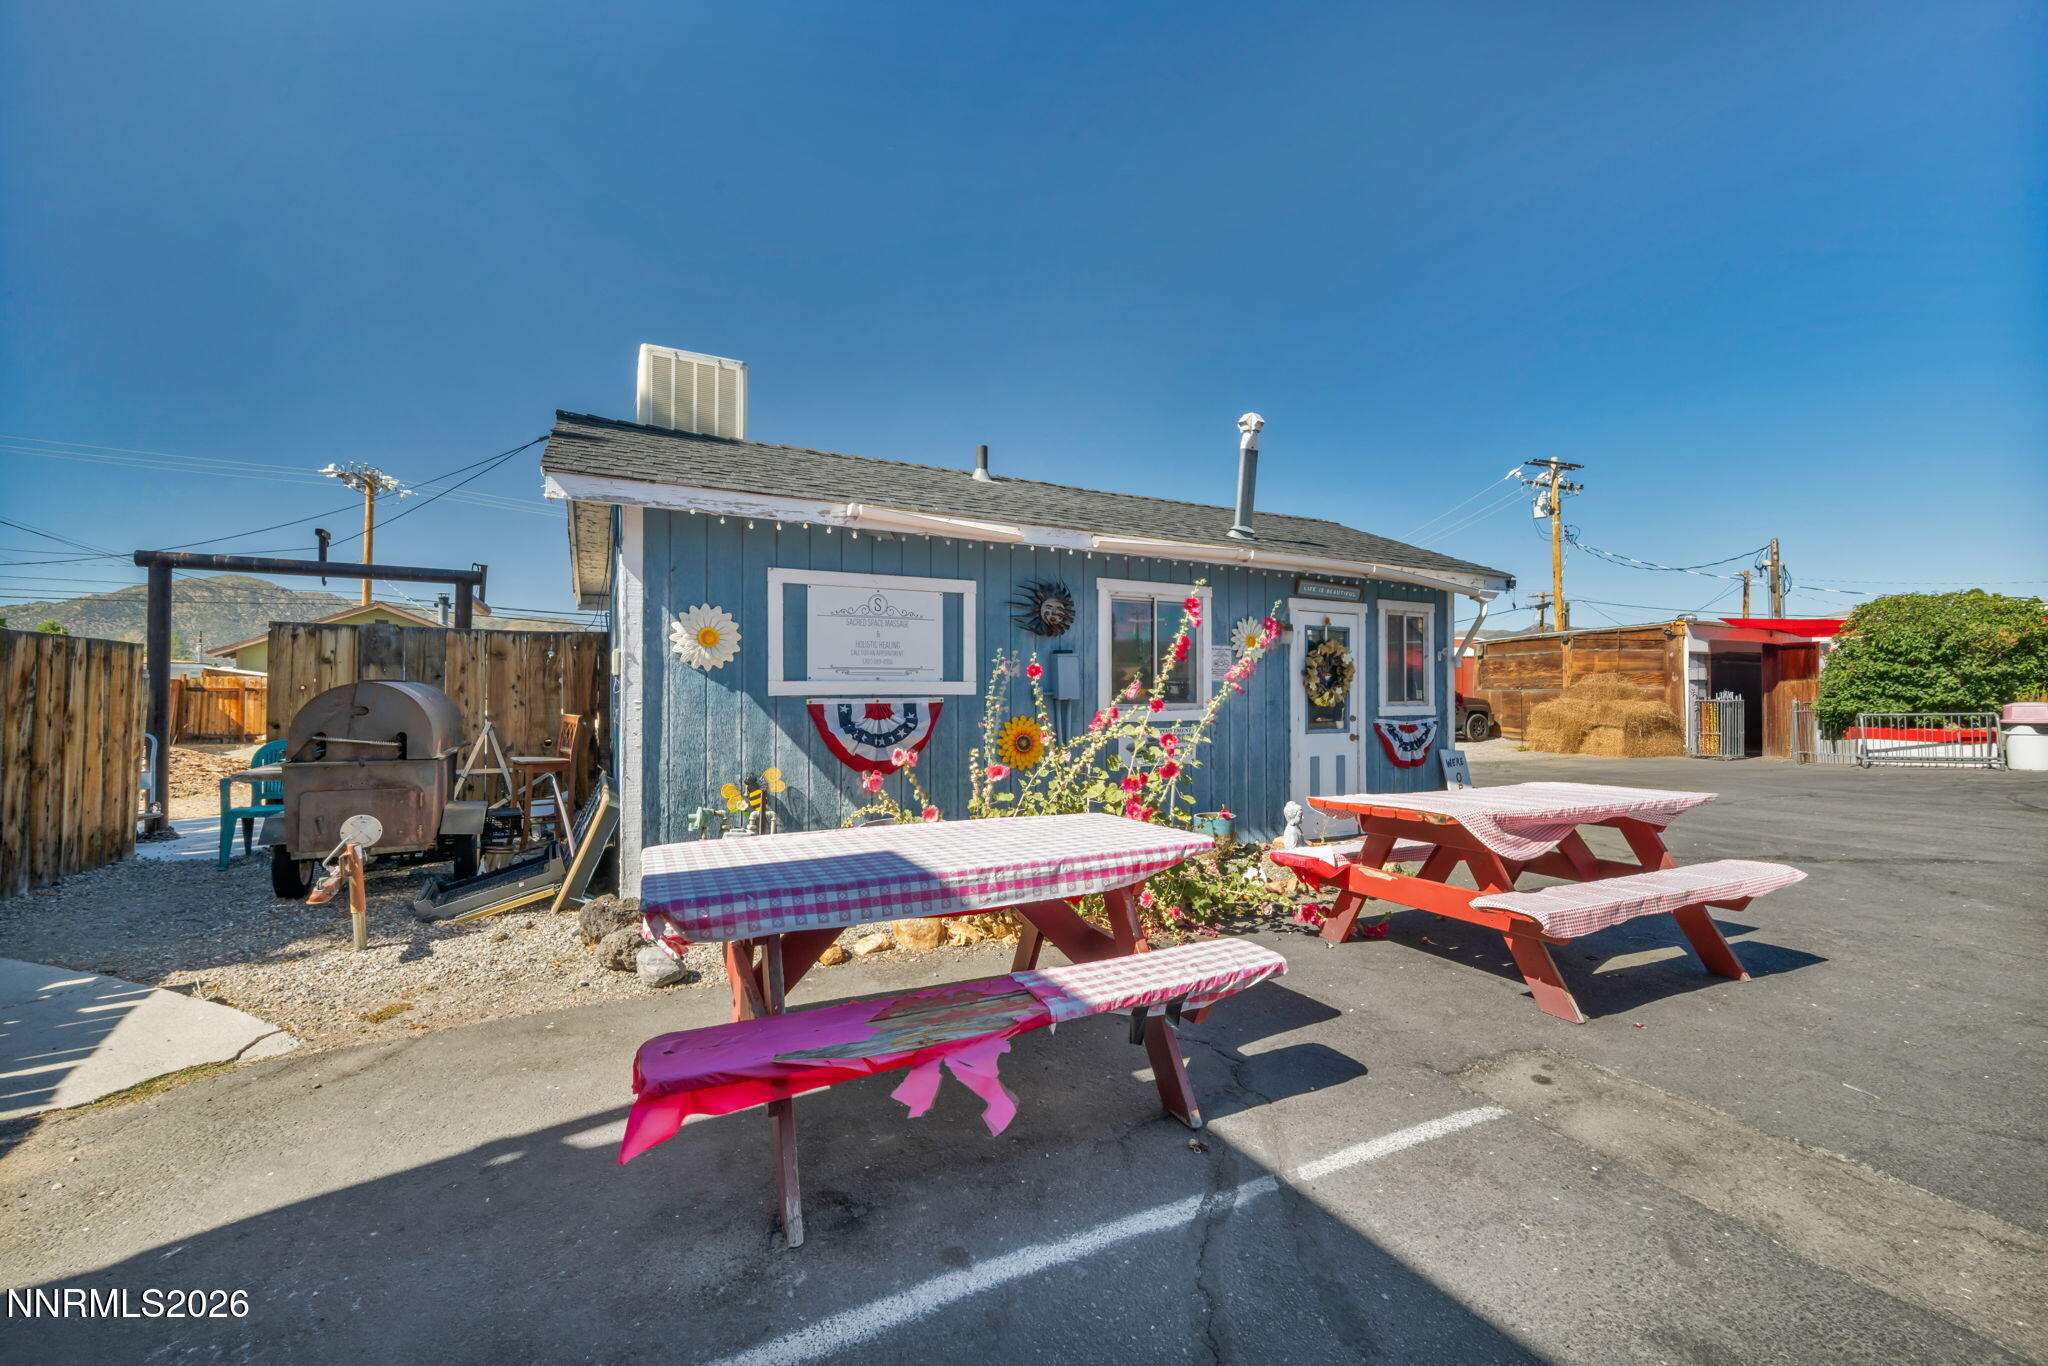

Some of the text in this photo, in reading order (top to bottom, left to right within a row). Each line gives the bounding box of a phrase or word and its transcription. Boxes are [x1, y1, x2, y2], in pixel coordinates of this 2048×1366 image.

[1326, 588, 1356, 597] BEAUTIFUL
[874, 598, 882, 612] S
[846, 618, 909, 628] SACRED SPACE MASSAGE
[856, 640, 901, 650] HOLISTIC HEALING
